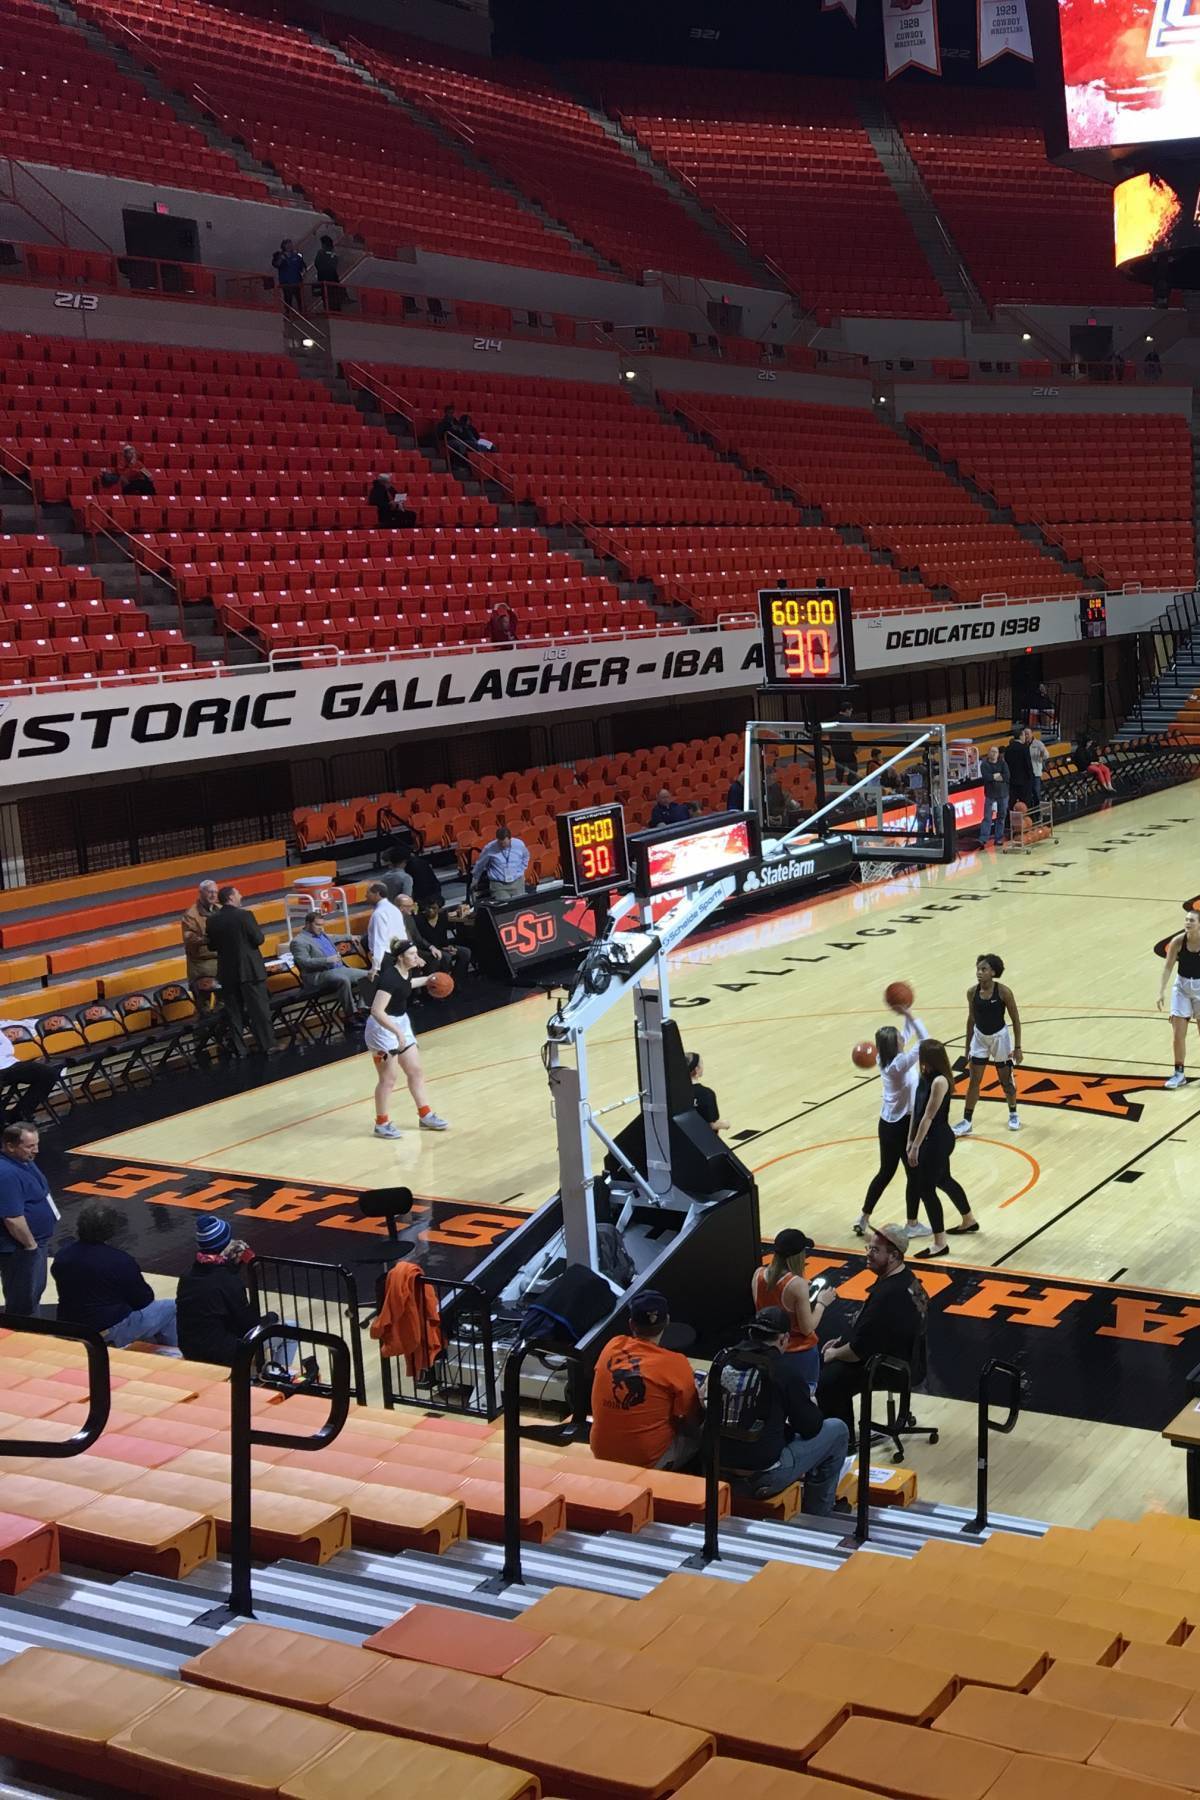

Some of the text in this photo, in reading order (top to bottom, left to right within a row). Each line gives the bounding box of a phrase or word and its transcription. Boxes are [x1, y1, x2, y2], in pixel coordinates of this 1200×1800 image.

[996, 5, 1017, 16] 1929
[900, 18, 919, 30] 1928
[992, 17, 1020, 27] COWBOY
[689, 28, 720, 40] 321
[896, 31, 924, 40] COWBOY
[990, 26, 1024, 35] WRESTLING
[894, 39, 926, 48] WRESTLING
[54, 292, 99, 311] 213
[473, 337, 502, 351] 214
[757, 370, 777, 381] 215
[1032, 387, 1060, 397] 216
[771, 600, 835, 626] 60:00
[886, 616, 1040, 650] DEDICATED 1938
[543, 648, 569, 660] 108
[784, 629, 830, 674] 30
[572, 817, 613, 848] 60:00
[1086, 817, 1195, 853] ARENA
[582, 845, 611, 879] 30
[698, 888, 723, 913] Sports
[500, 909, 558, 957] OSU
[62, 1166, 524, 1248] STATE
